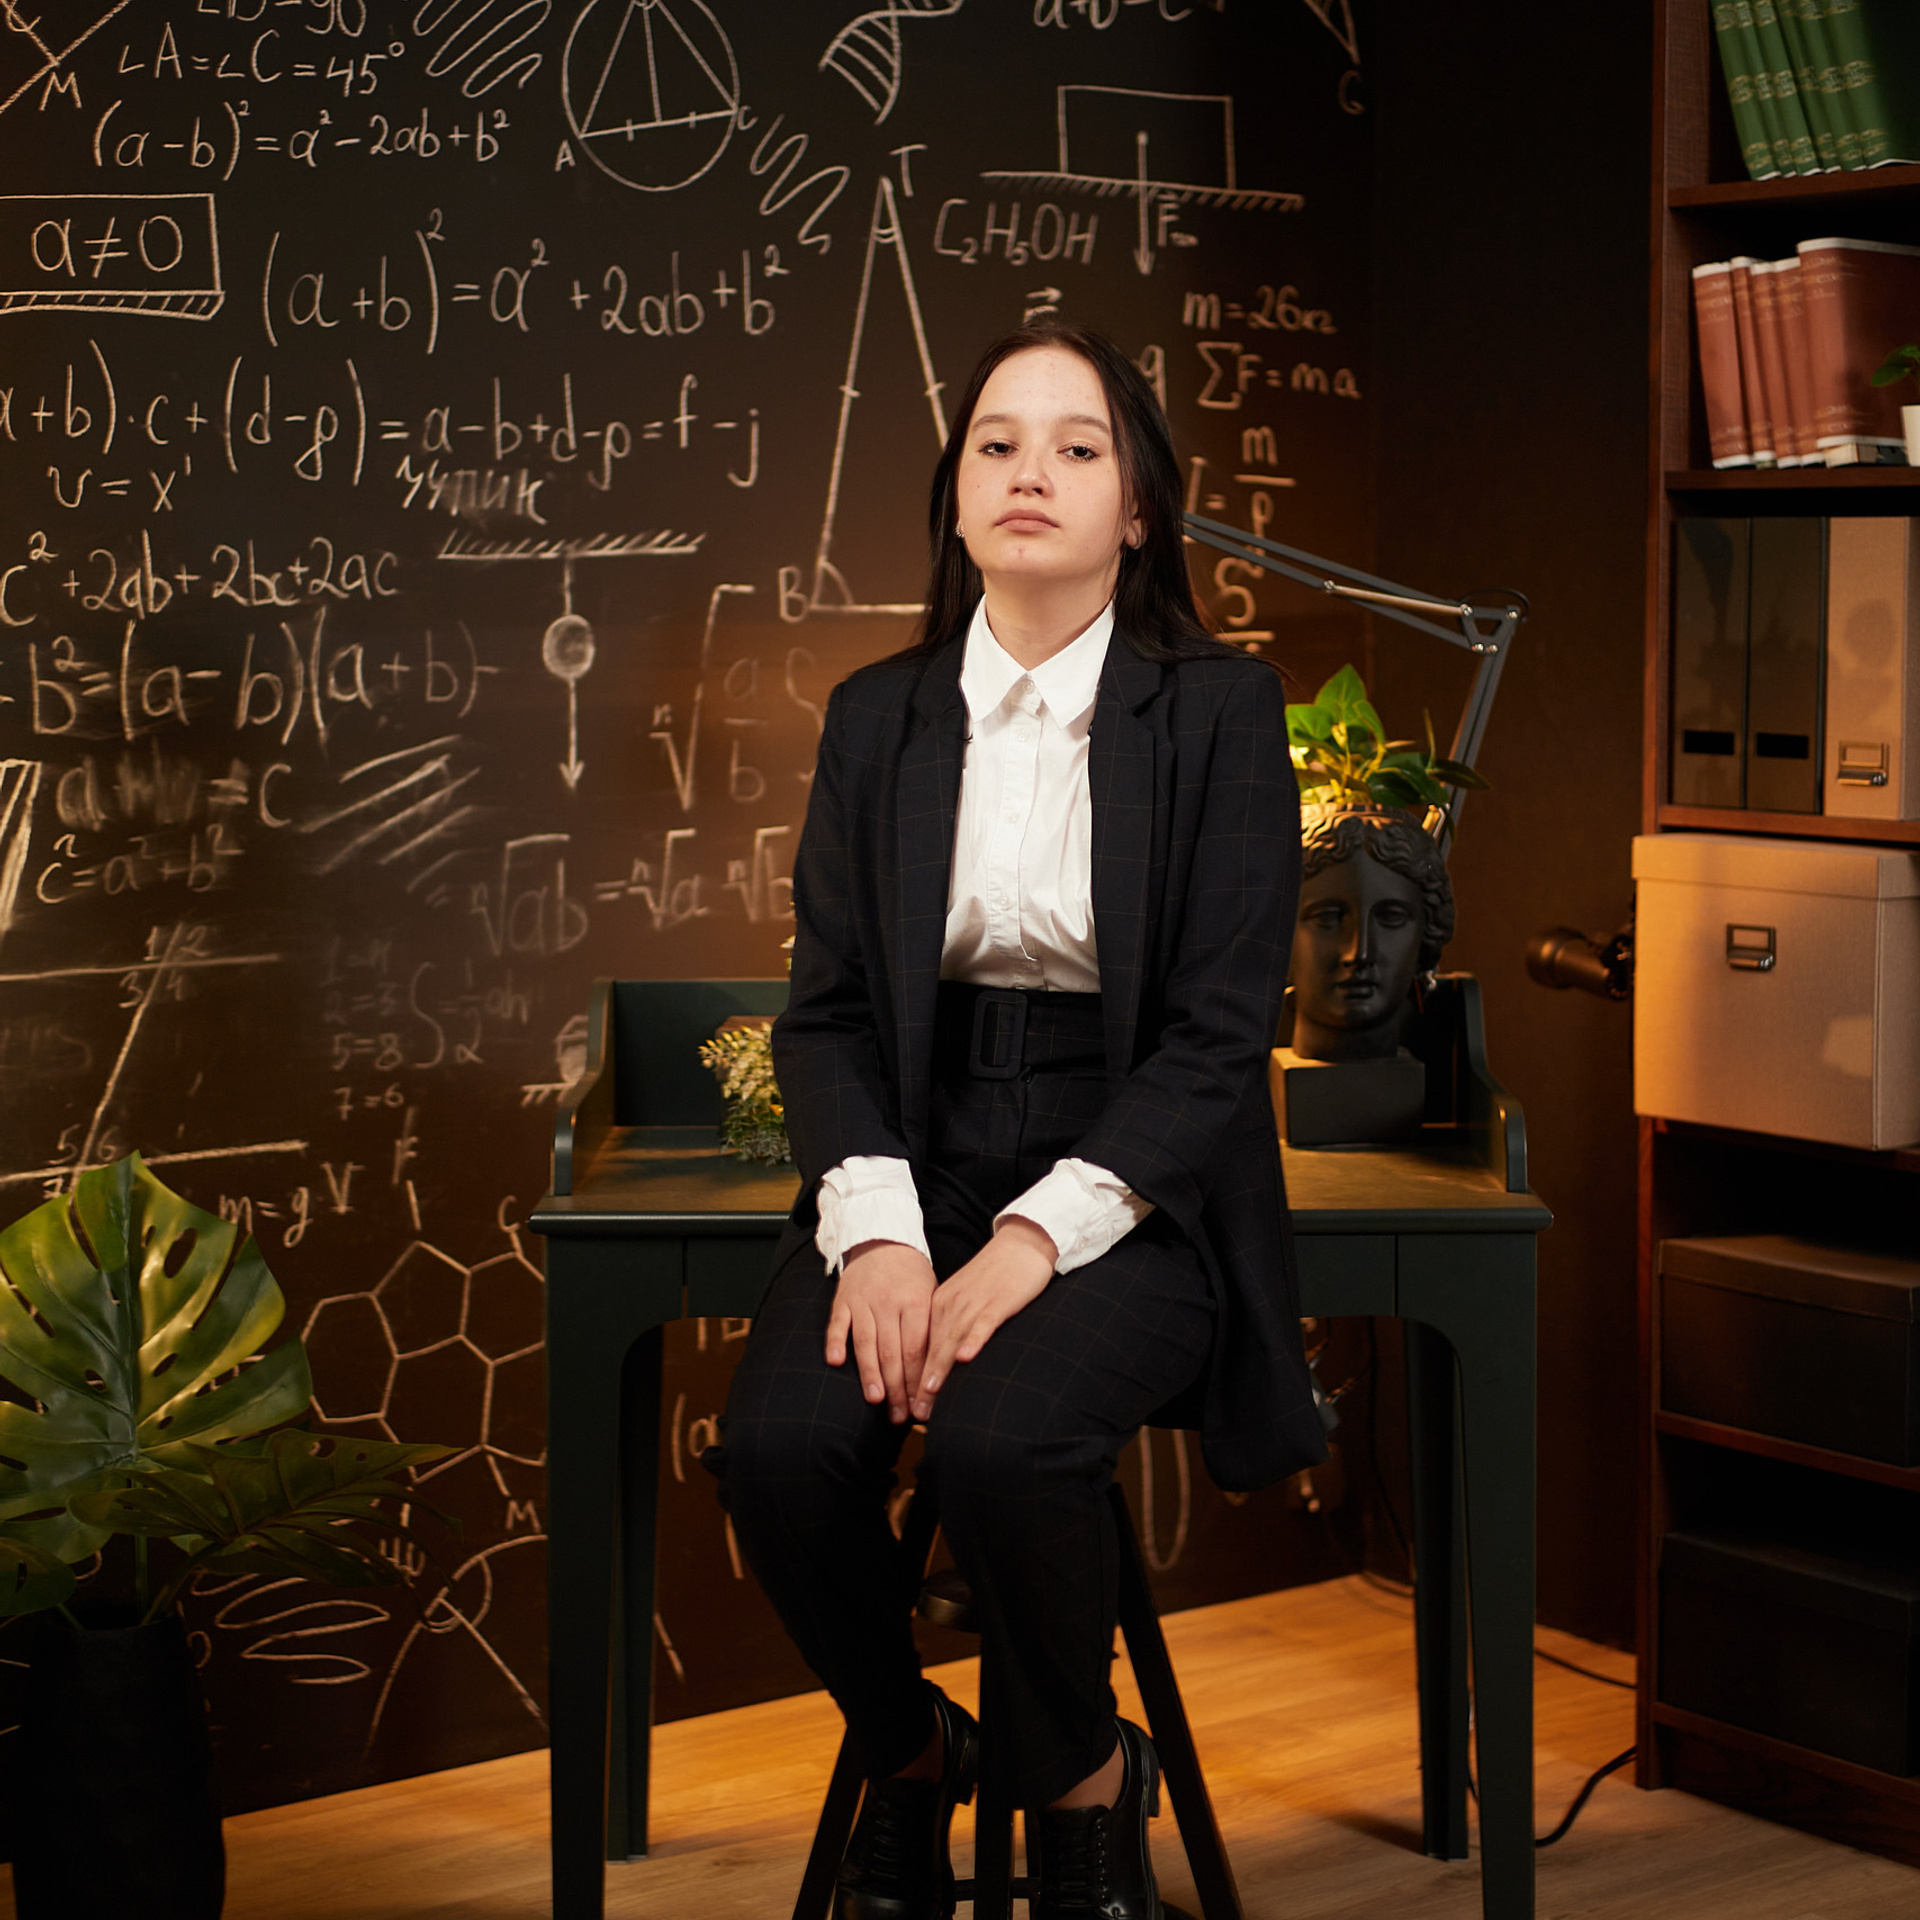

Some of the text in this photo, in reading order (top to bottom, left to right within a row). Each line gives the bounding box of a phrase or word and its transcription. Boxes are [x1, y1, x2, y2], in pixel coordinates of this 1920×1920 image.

[38, 71, 82, 111] M
[555, 140, 576, 172] A
[889, 144, 928, 197] T
[778, 566, 807, 623] B
